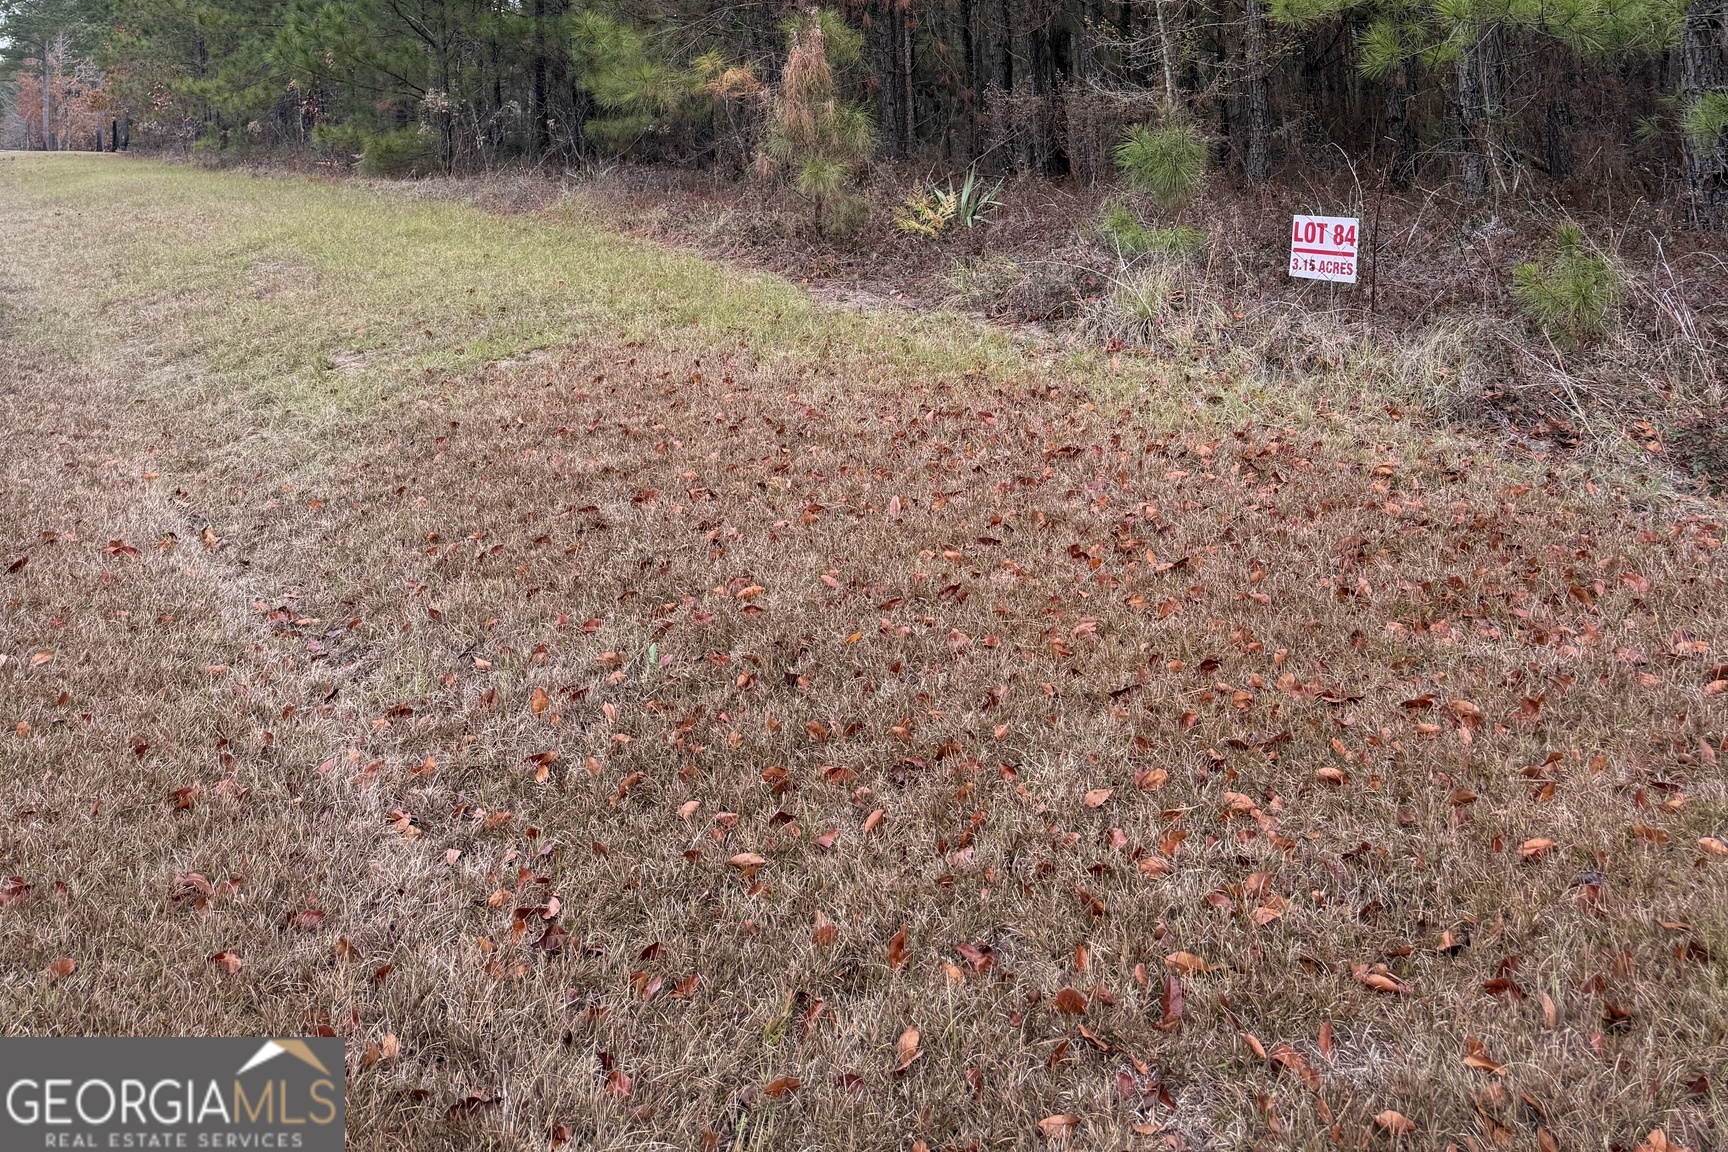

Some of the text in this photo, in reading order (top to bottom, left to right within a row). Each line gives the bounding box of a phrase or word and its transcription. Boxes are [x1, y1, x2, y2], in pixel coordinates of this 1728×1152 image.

[1293, 221, 1356, 246] LOT 84
[1292, 258, 1354, 276] 3.15 ACRES
